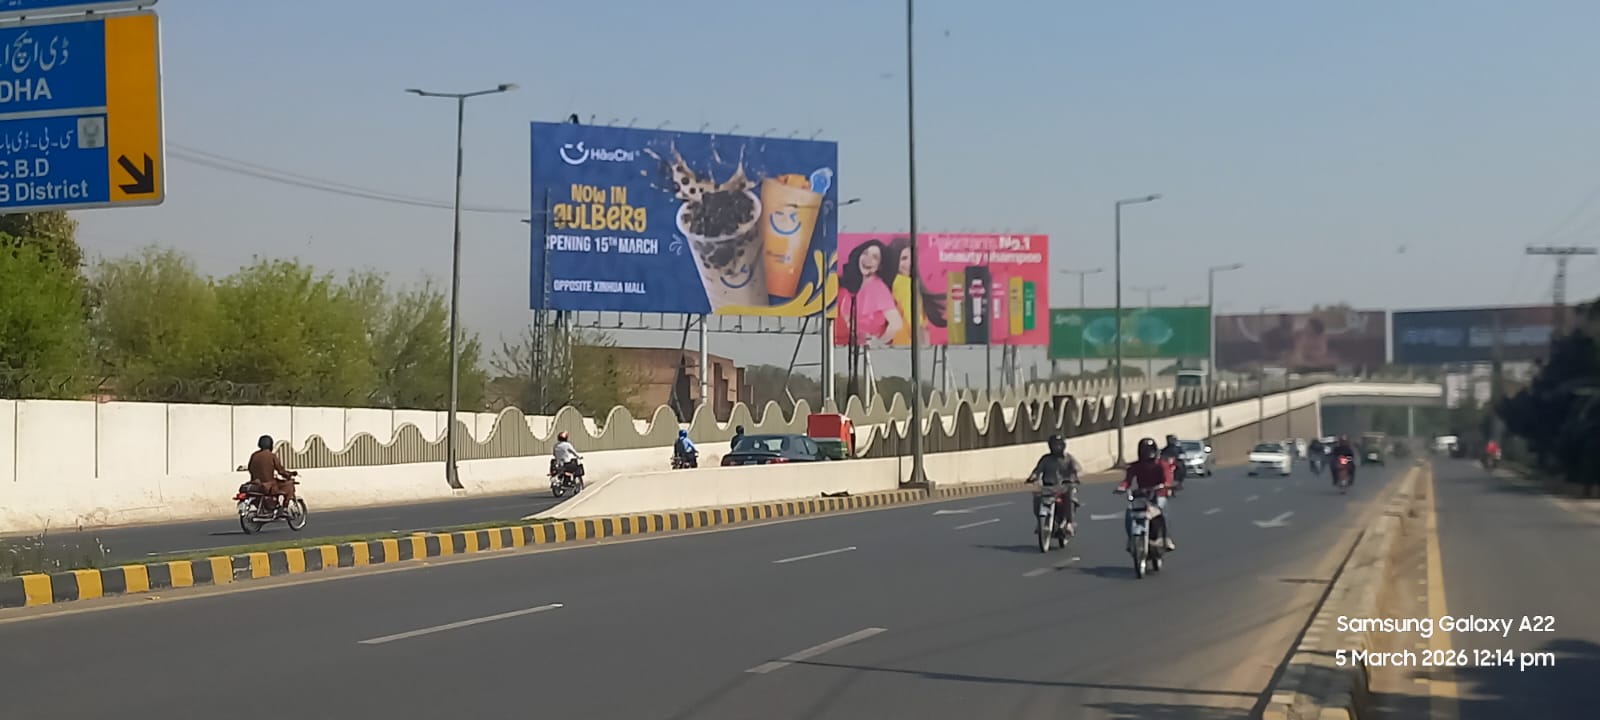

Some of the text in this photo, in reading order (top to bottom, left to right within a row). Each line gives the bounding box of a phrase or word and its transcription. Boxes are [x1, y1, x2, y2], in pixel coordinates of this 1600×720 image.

[0, 76, 52, 103] DHA
[0, 157, 49, 179] C.B.D
[15, 178, 89, 201] District
[610, 185, 627, 205] IN
[618, 238, 658, 255] MARCH
[553, 279, 593, 292] OPPOSITE
[624, 281, 646, 294] MALL
